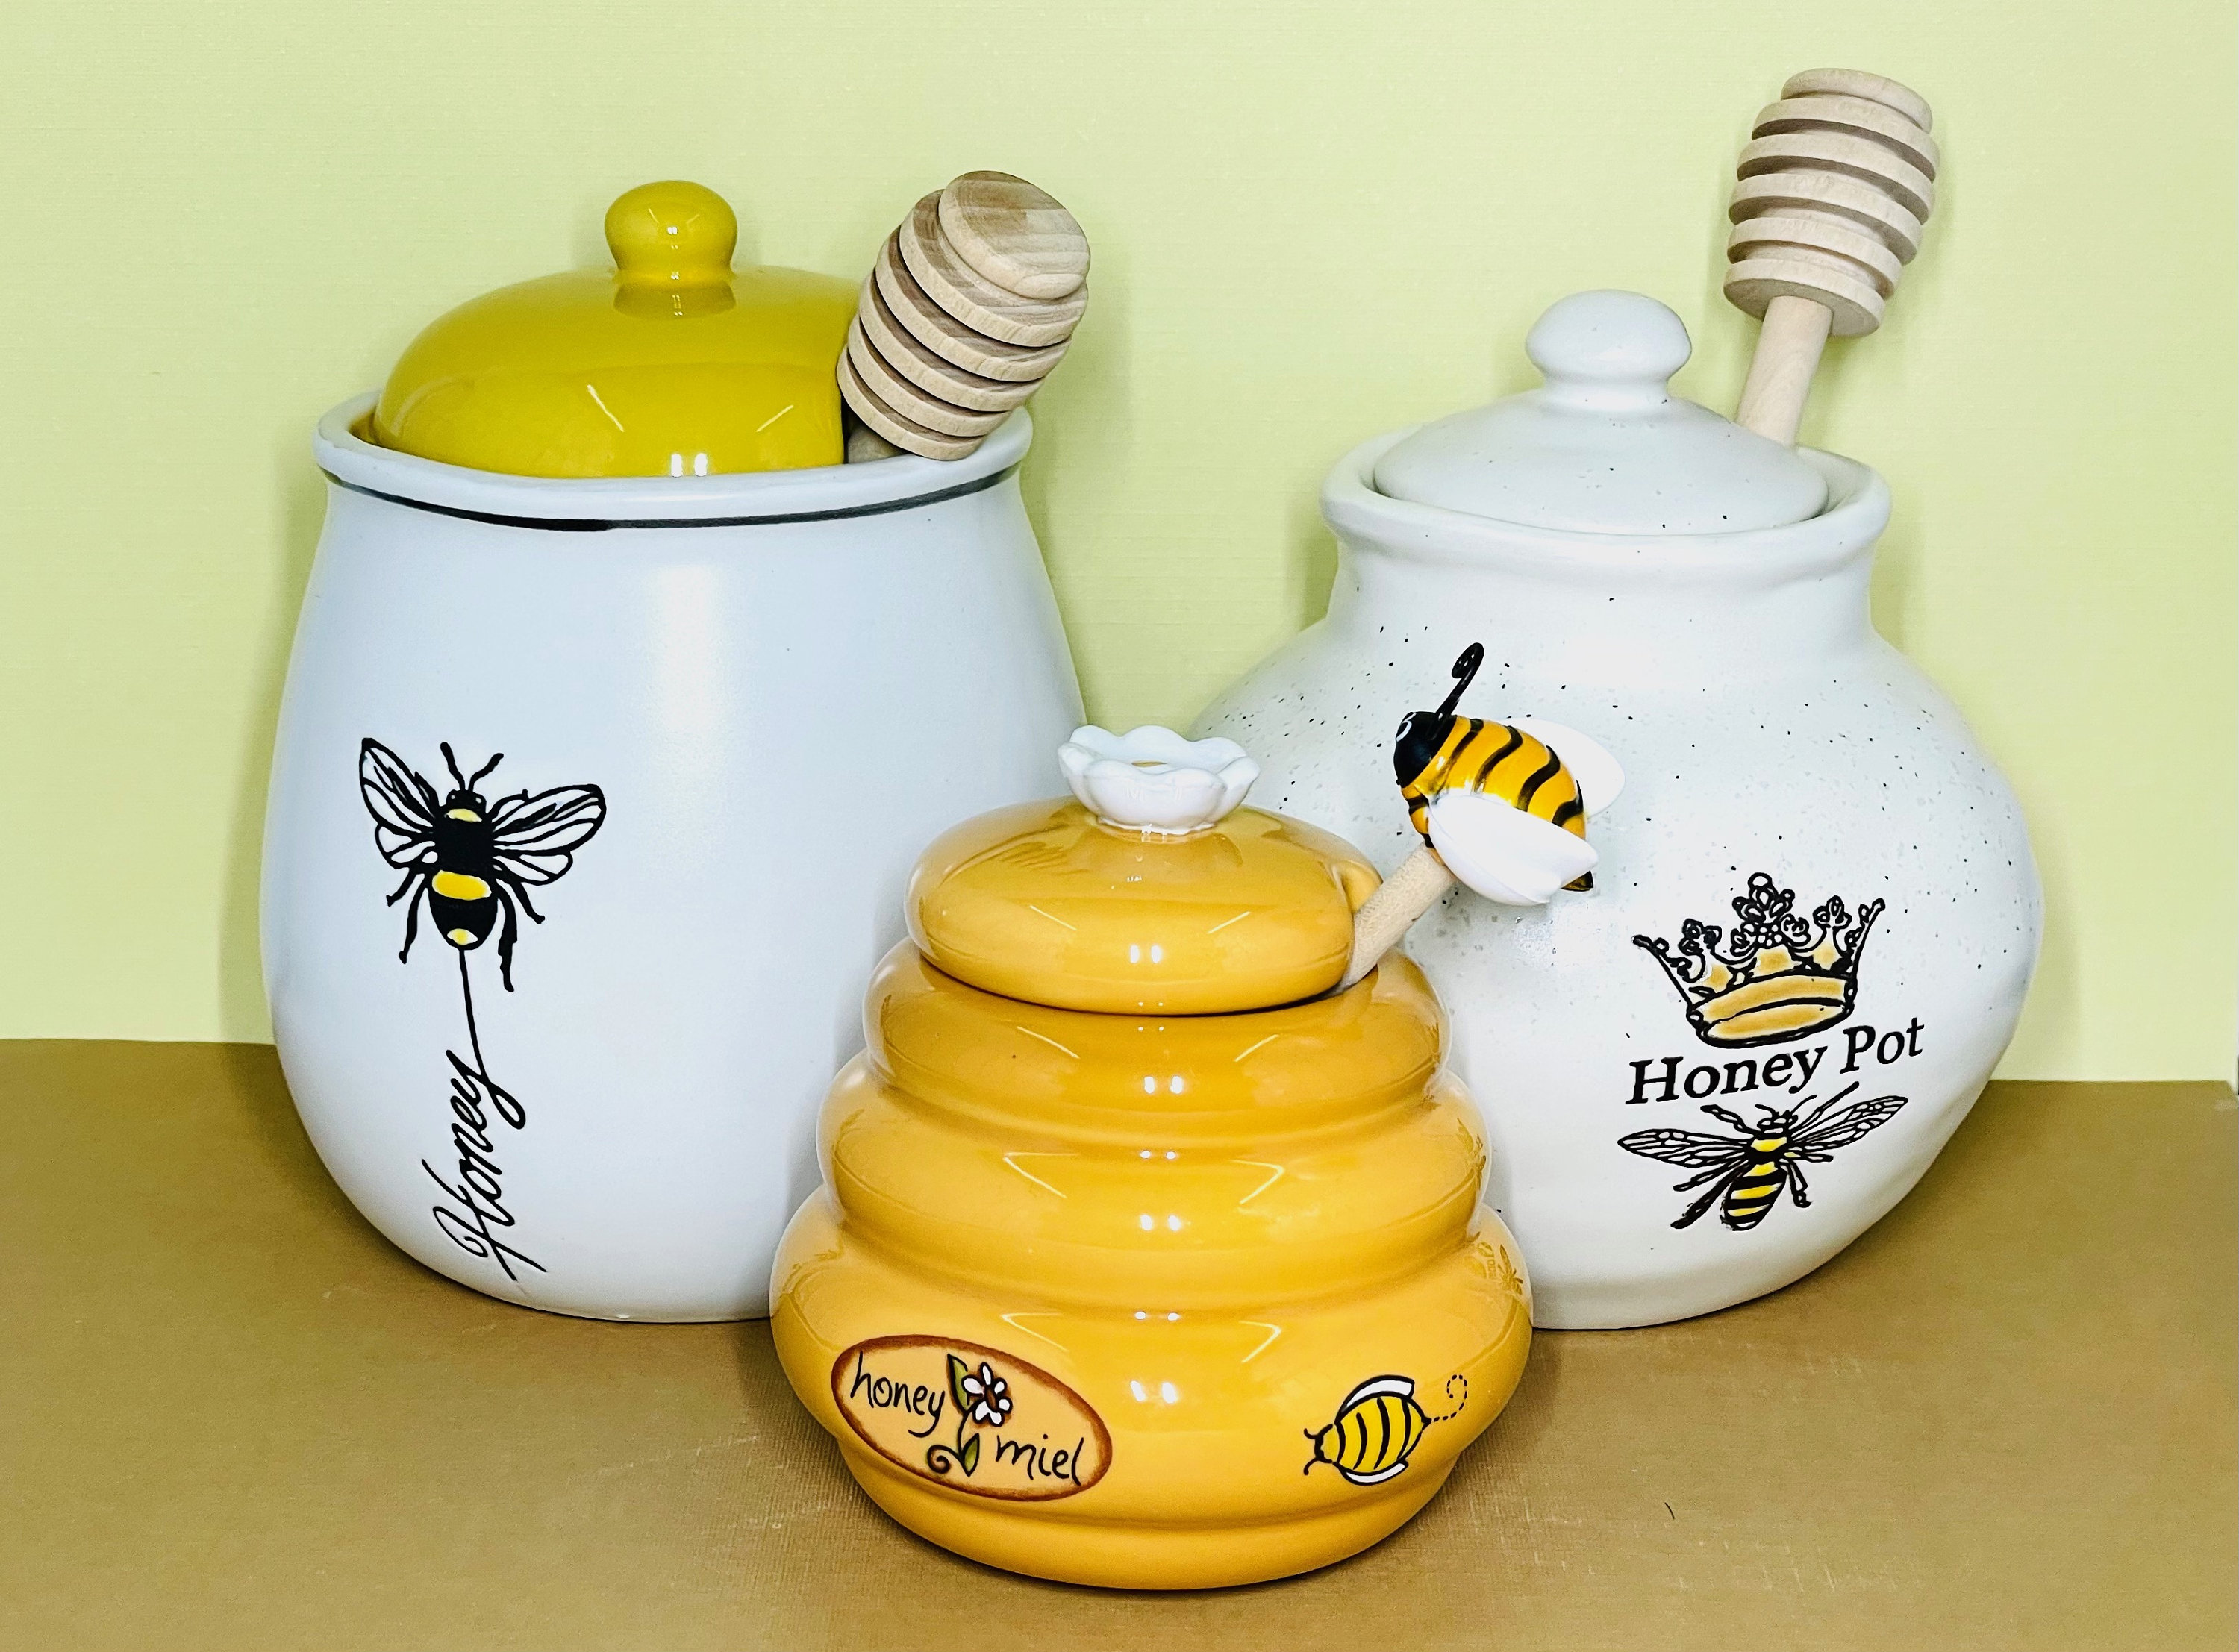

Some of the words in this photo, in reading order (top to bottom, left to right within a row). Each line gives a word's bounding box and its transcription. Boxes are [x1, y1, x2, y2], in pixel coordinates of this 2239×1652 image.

[1625, 1045, 1828, 1105] Honey
[1840, 1017, 1925, 1074] Pot
[421, 1049, 548, 1282] Honey
[849, 1351, 946, 1439] honey
[994, 1433, 1084, 1486] miel
